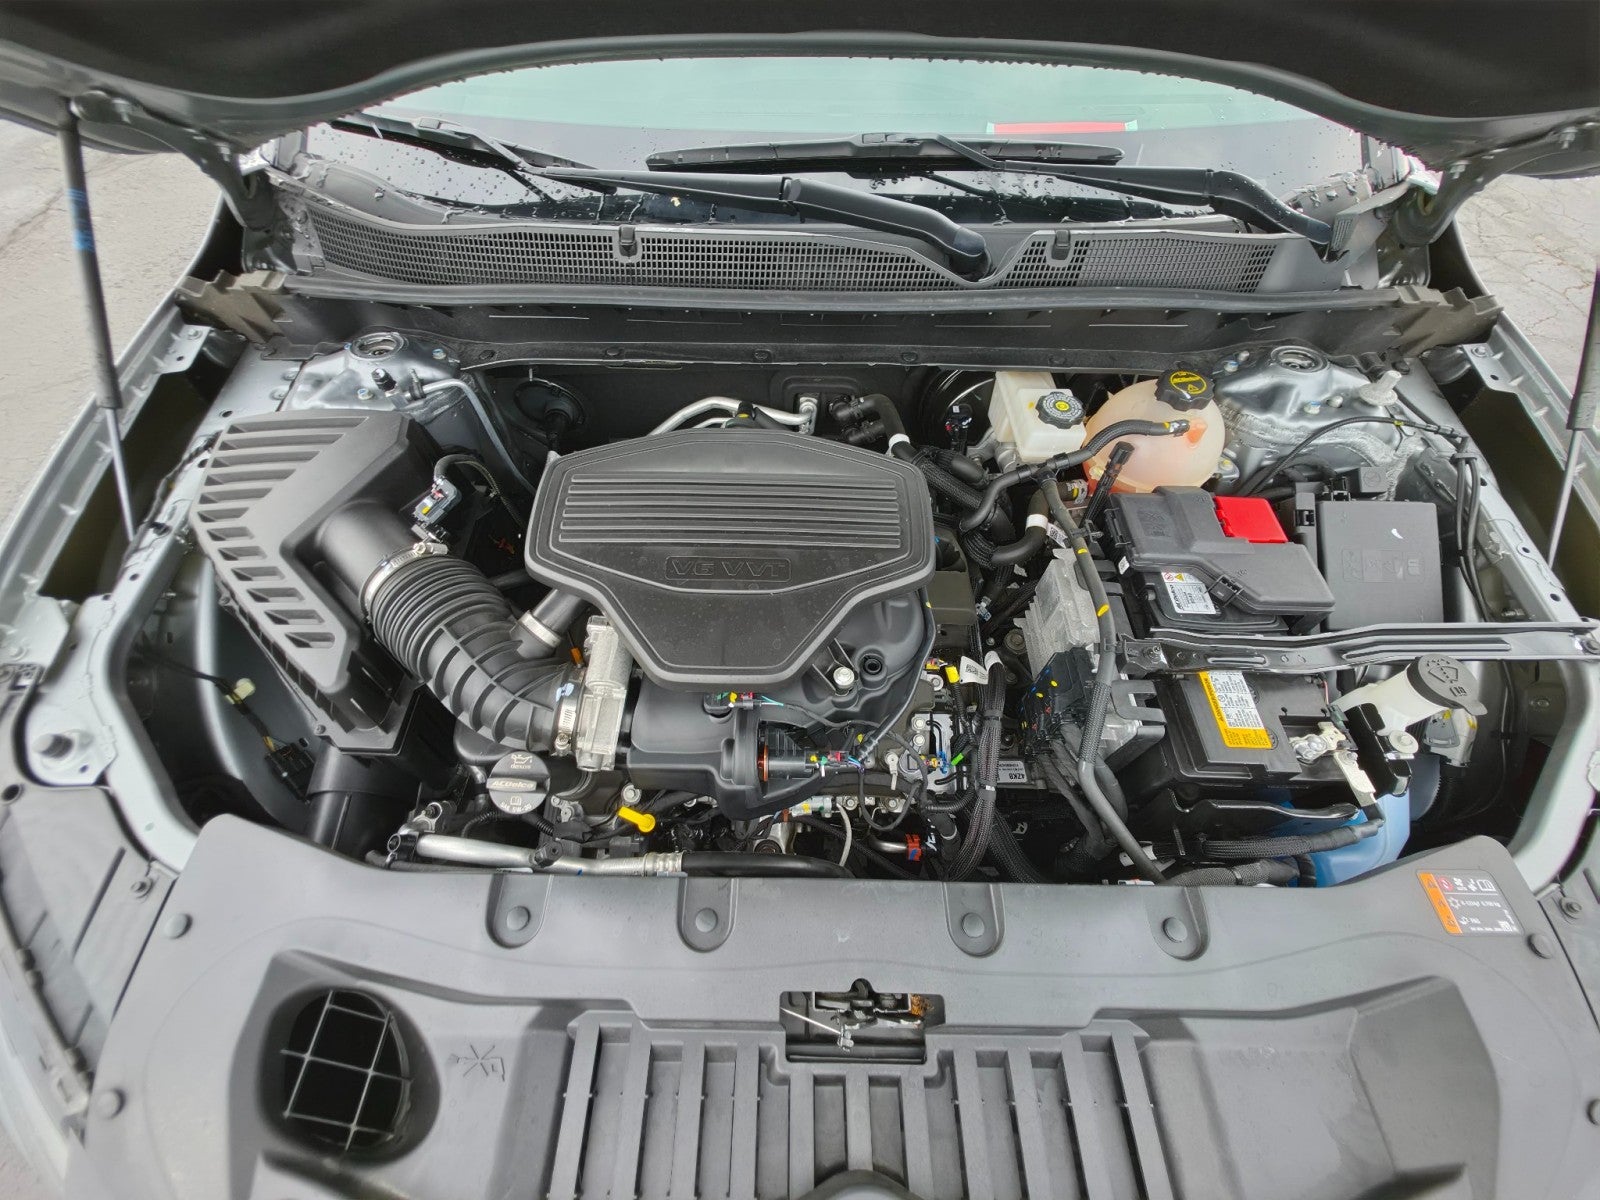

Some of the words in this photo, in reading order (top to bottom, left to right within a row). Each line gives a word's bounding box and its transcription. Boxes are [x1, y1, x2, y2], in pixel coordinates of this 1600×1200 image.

[671, 559, 715, 576] V6
[721, 561, 786, 577] VVT
[492, 780, 534, 788] ACDelco
